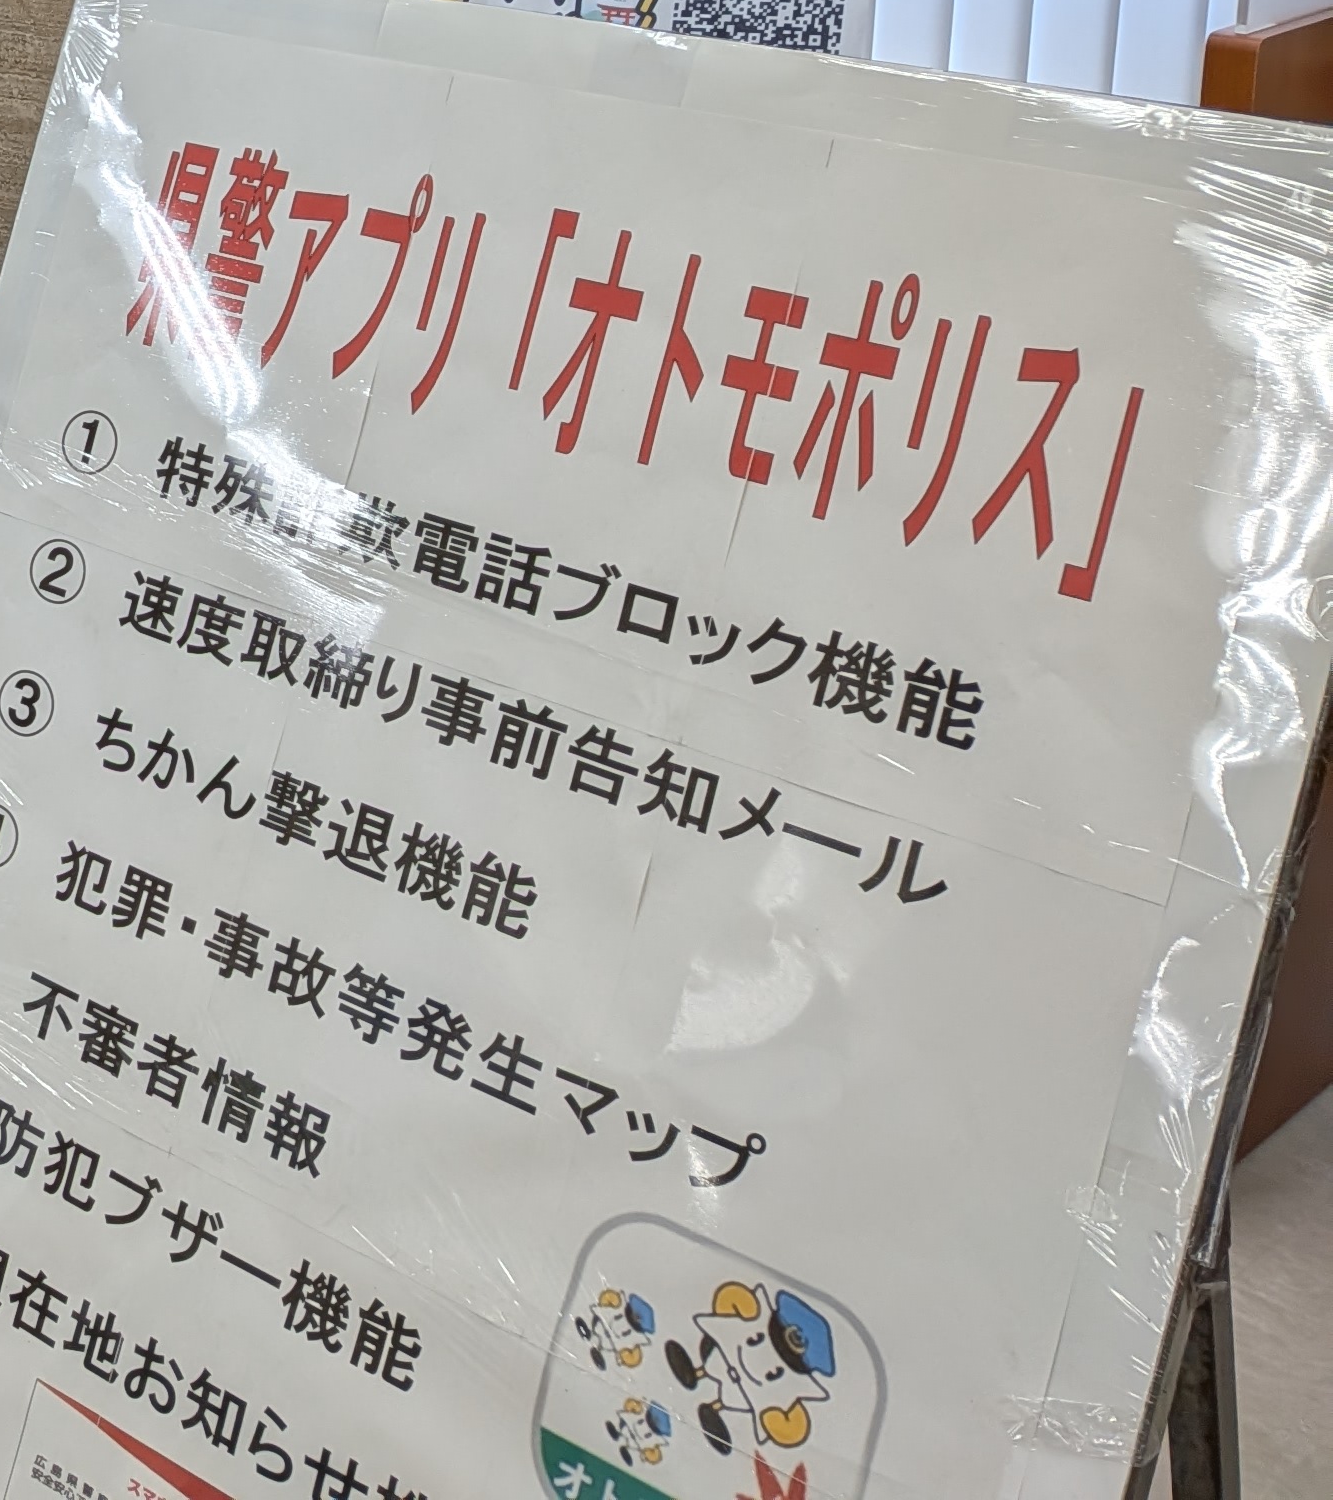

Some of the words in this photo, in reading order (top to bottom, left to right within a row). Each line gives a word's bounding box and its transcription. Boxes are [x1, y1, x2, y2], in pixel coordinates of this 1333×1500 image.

[95, 708, 538, 941] ちかん撃退機能
[119, 570, 949, 906] 速度取締り事前告知メール
[22, 970, 333, 1179] 不審者情報
[55, 839, 768, 1191] 犯罪・事故等発生マップ
[127, 1477, 167, 1500] スマ
